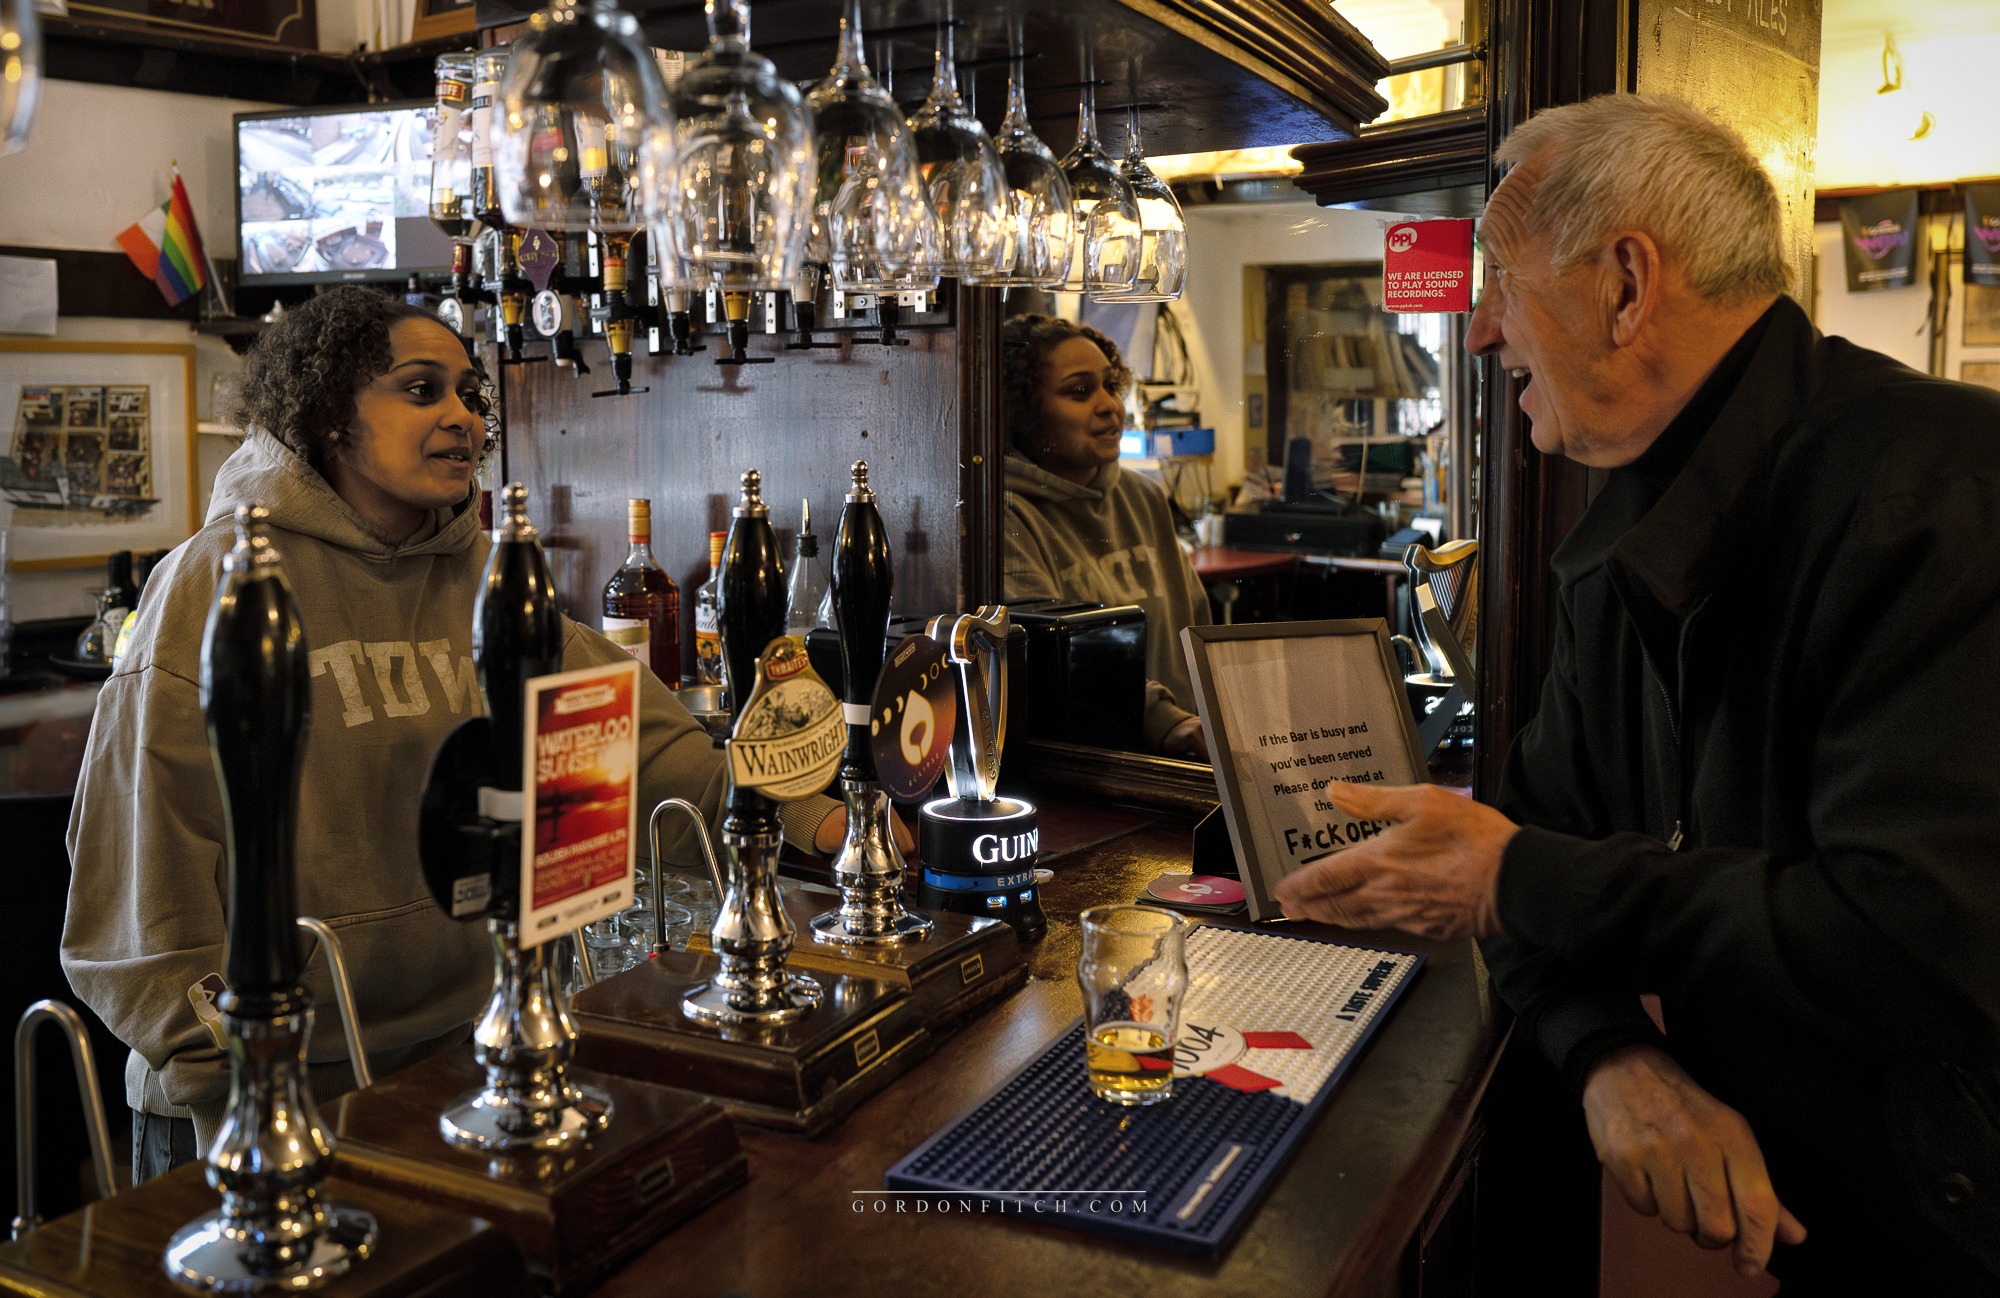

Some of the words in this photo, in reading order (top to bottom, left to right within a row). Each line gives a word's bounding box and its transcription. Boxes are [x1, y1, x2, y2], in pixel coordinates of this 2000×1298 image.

[1392, 233, 1413, 247] PPL
[1388, 272, 1401, 280] WE
[1404, 271, 1421, 280] ARE
[1423, 270, 1464, 280] LICENSED
[1388, 281, 1399, 289] TO
[1402, 280, 1423, 289] PLAY
[1425, 279, 1459, 289] SOUND
[1387, 289, 1446, 298] RECORDINGS.
[538, 715, 631, 757] WATERLOO
[1259, 735, 1267, 746] If
[1269, 733, 1288, 746] the
[1290, 731, 1308, 743] Bar
[1310, 729, 1320, 740] is
[1321, 727, 1346, 738] busy
[1348, 722, 1368, 735] and
[737, 718, 846, 777] WAINWRIGHT
[1270, 756, 1307, 773] you've
[1308, 753, 1336, 765] been
[1337, 746, 1372, 760] served
[1273, 782, 1310, 796] Please
[1373, 770, 1385, 780] at
[1314, 800, 1334, 812] the
[1341, 991, 1374, 1013] TASTE
[1335, 1014, 1356, 1022] A
